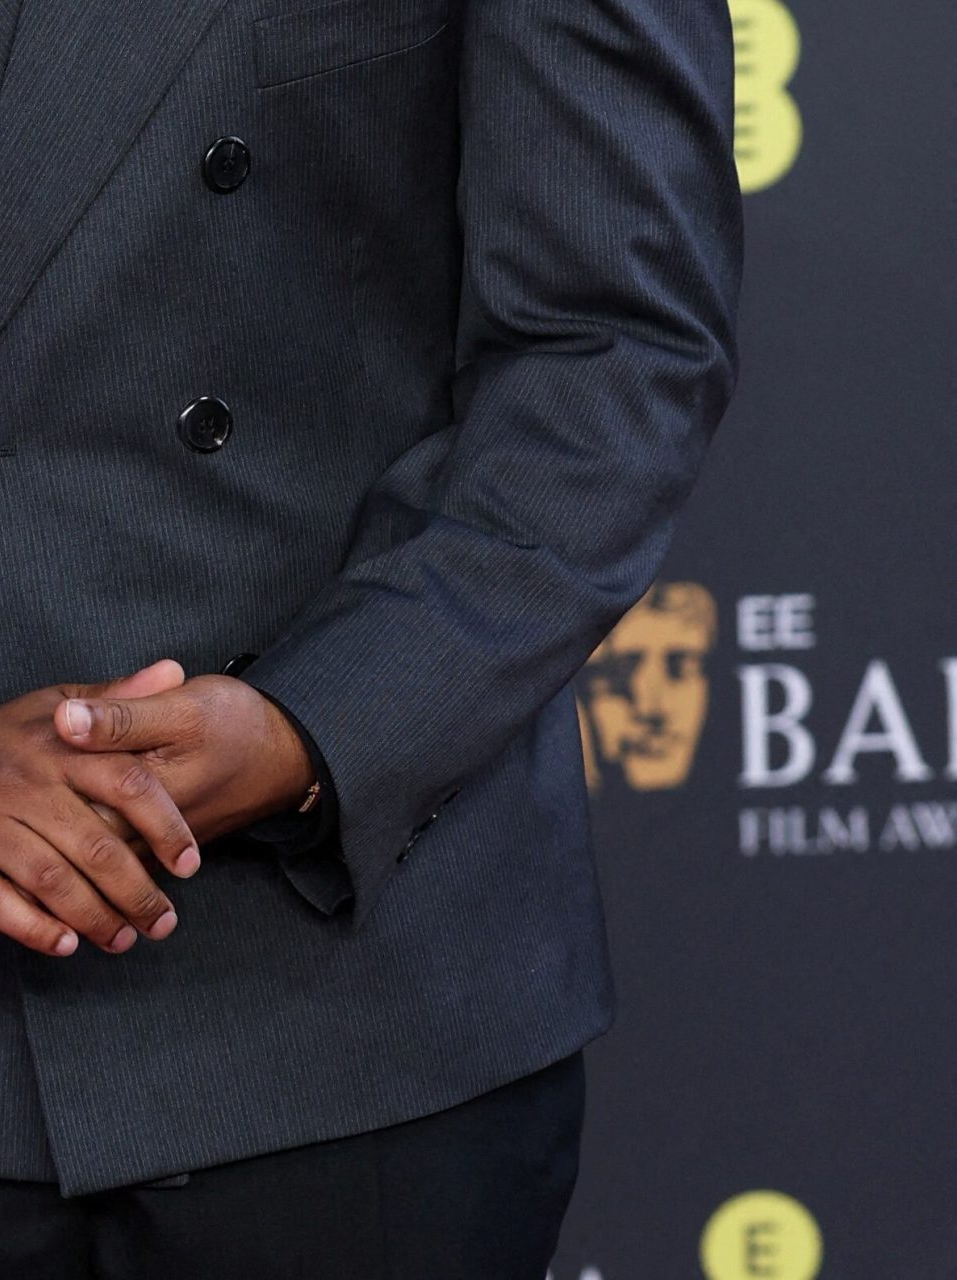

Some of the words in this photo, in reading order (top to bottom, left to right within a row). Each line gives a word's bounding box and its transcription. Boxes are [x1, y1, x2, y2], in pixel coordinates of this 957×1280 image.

[738, 594, 815, 650] EE
[739, 658, 957, 786] BA
[739, 807, 869, 856] FILM
